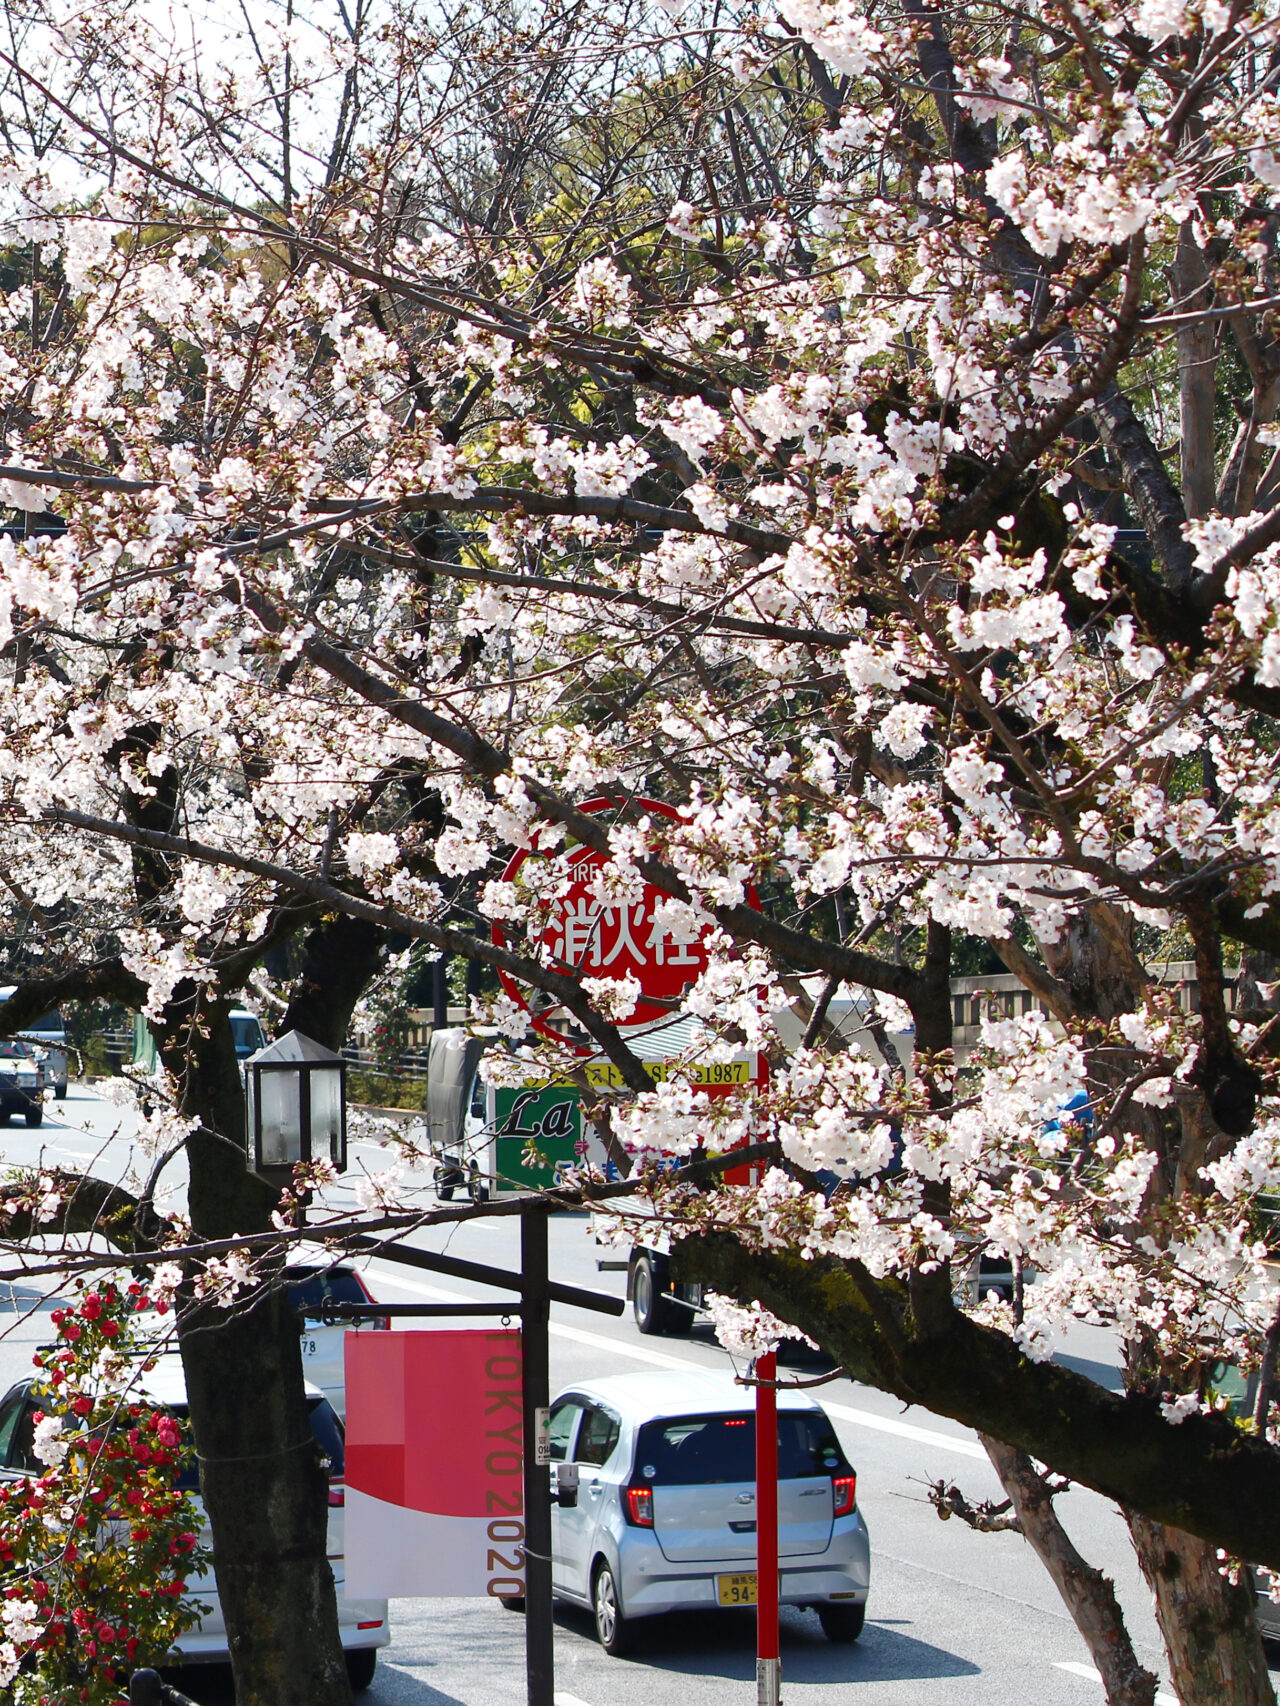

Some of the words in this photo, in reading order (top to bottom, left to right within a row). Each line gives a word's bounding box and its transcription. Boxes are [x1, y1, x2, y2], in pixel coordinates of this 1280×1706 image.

[549, 895, 701, 968] 消火栓
[652, 1064, 743, 1084] Sie1987
[498, 1090, 575, 1139] La
[484, 1334, 523, 1476] TOKYO
[486, 1490, 526, 1598] 2020
